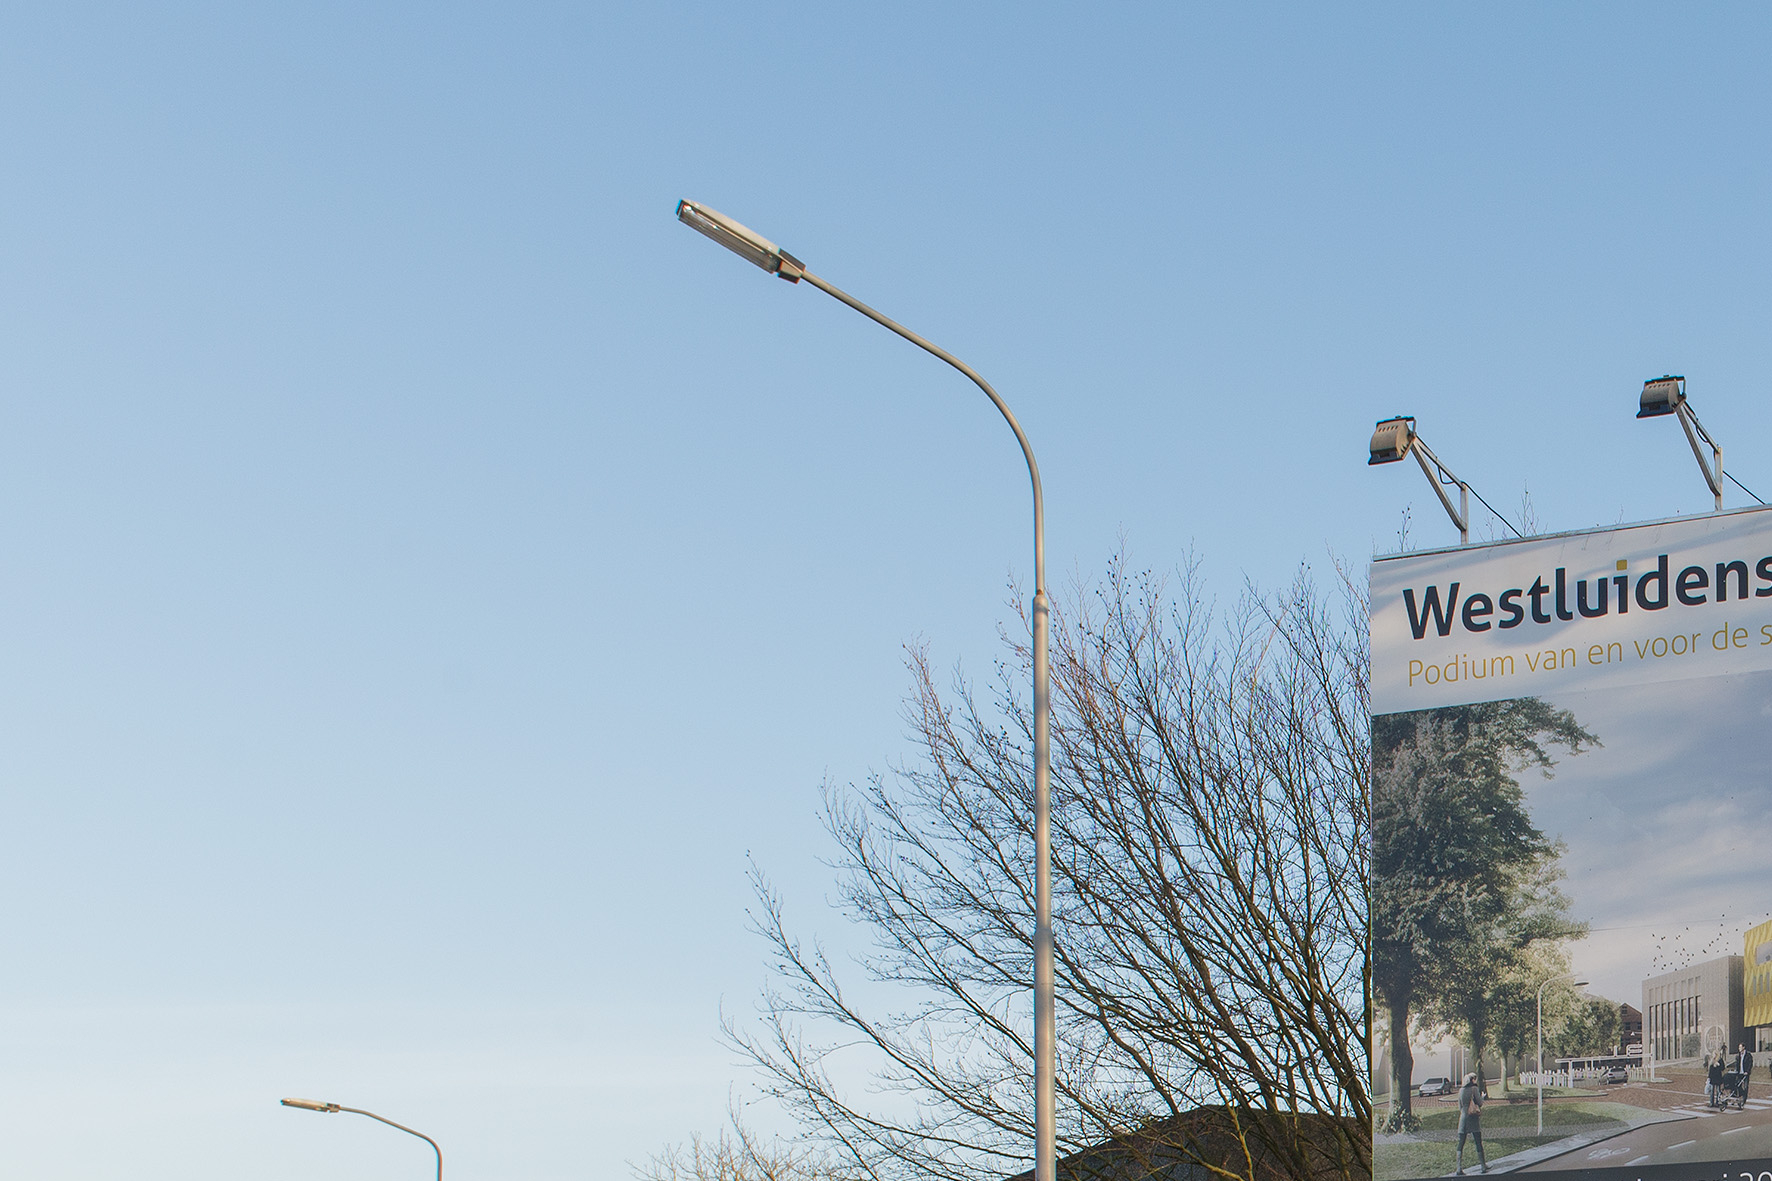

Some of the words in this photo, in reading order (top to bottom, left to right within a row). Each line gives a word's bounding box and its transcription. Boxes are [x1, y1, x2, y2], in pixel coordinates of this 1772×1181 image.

[1409, 654, 1514, 686] Podium
[1526, 648, 1575, 672] van
[1588, 643, 1622, 664] en
[1634, 633, 1701, 659] voor
[1712, 622, 1748, 650] de
